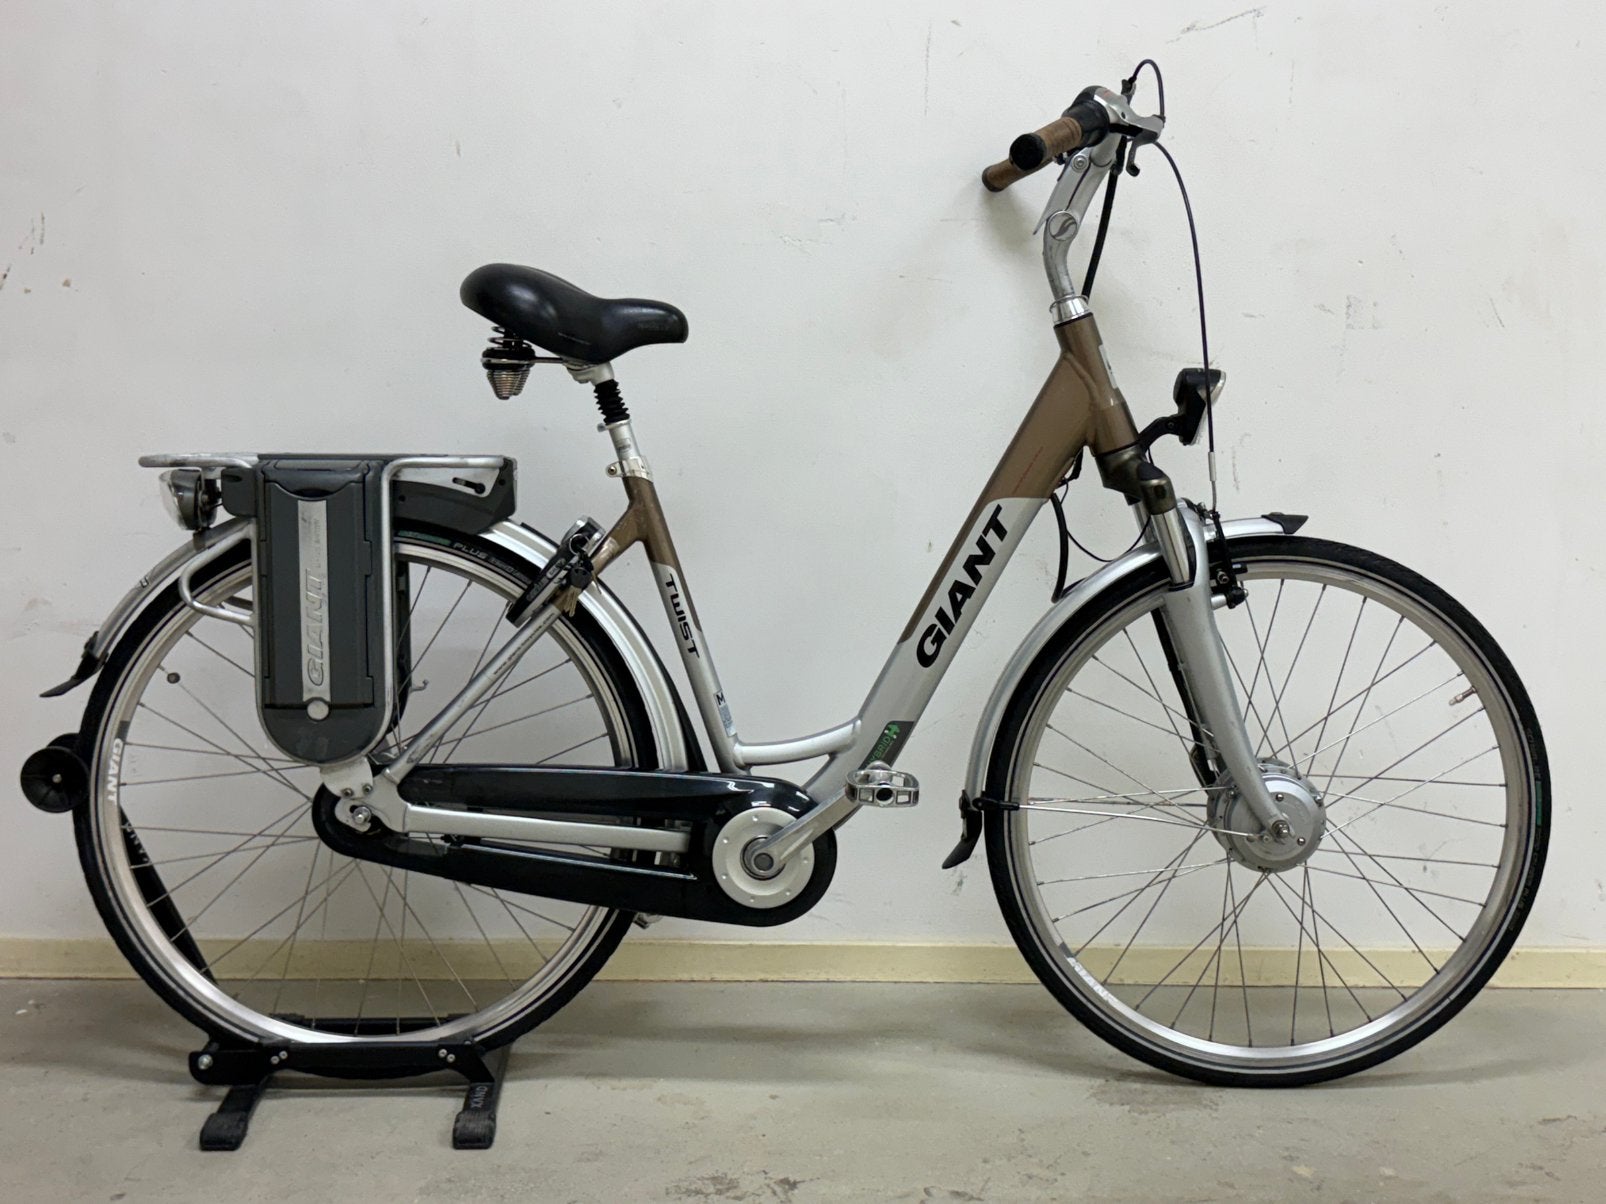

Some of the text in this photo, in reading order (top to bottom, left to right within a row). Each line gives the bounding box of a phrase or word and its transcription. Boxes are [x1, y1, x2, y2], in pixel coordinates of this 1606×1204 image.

[453, 541, 489, 559] PLUS
[666, 573, 700, 658] TWIST
[916, 504, 1008, 669] GIANT
[306, 566, 326, 688] GIANT
[715, 691, 726, 706] M
[107, 738, 122, 806] GIANT
[868, 736, 892, 764] YBRID
